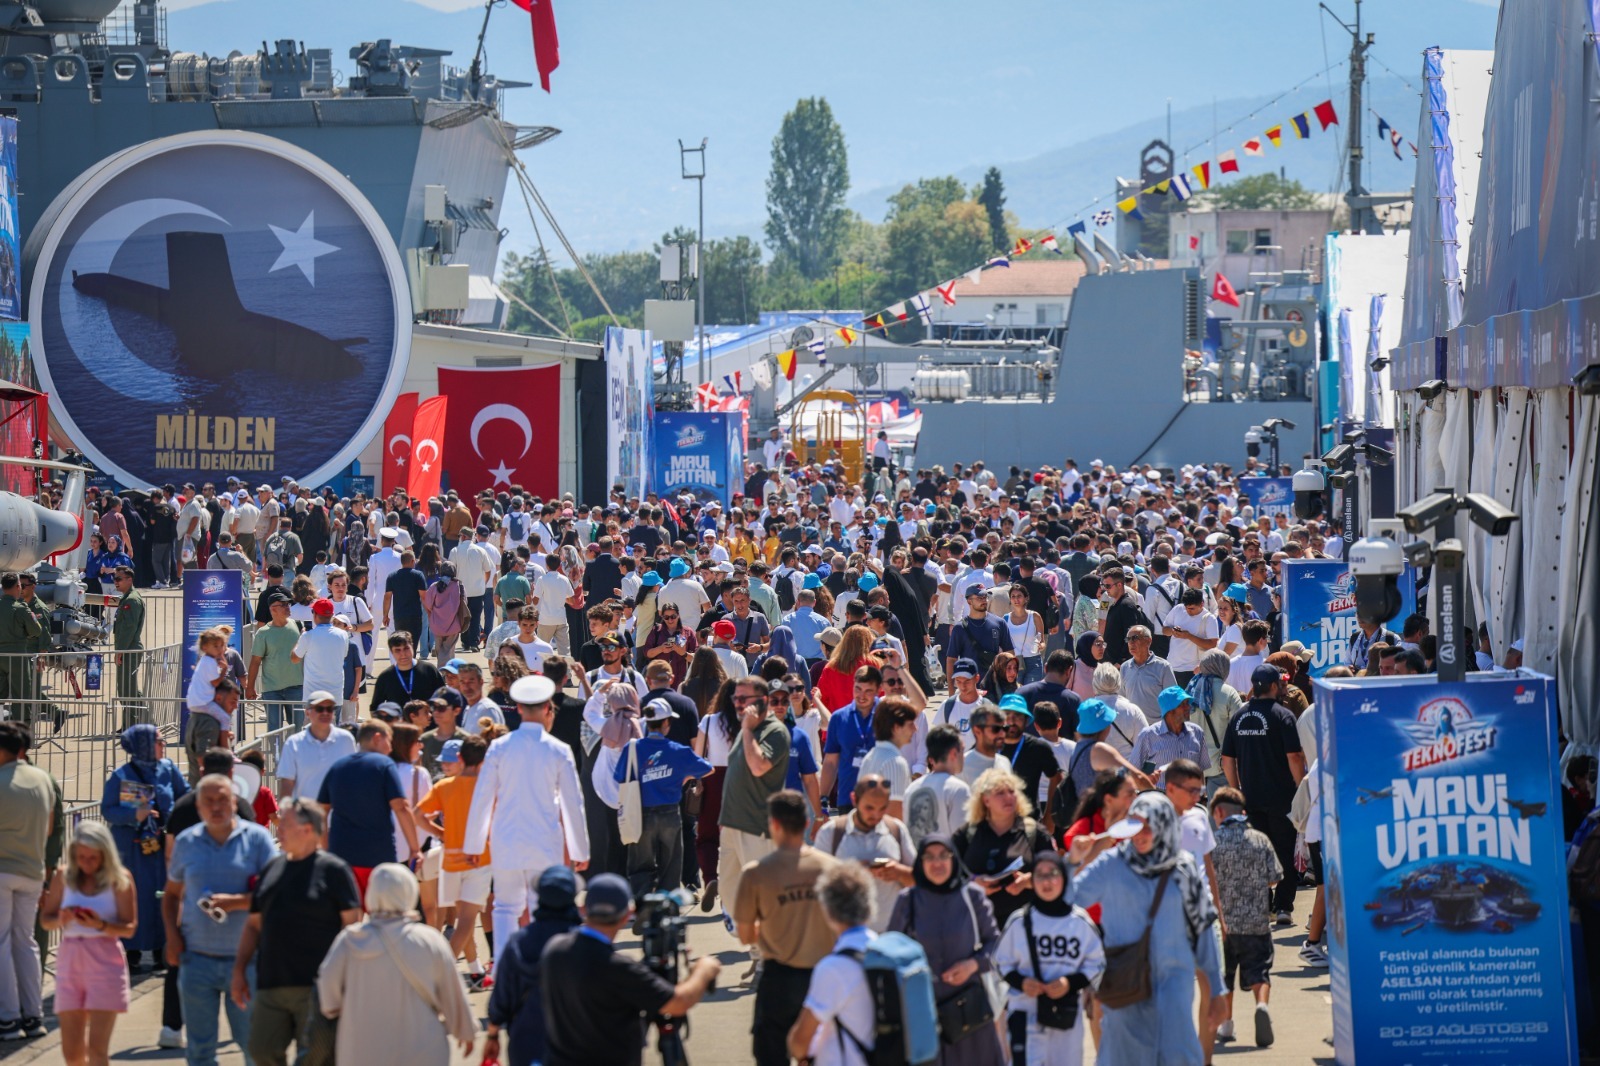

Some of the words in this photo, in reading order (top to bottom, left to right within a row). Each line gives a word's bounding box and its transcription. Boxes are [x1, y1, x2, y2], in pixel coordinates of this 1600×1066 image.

[155, 409, 276, 451] MİLDEN
[155, 450, 197, 470] MİLLİ
[200, 451, 275, 471] DENİZALTI
[664, 469, 717, 487] VATAN
[1344, 497, 1352, 530] aselsan
[1440, 585, 1453, 642] aselsan
[1402, 727, 1498, 772] TEKNOFEST
[1375, 814, 1532, 870] VATAN
[1033, 934, 1081, 959] 993
[1379, 949, 1429, 961] Festival
[1431, 948, 1486, 960] alanında
[1488, 946, 1540, 957] bulunan
[1384, 964, 1409, 975] tüm
[1412, 961, 1466, 975] güvenlik
[1469, 960, 1536, 972] kameraları
[1381, 976, 1442, 988] ASELSAN
[1445, 974, 1510, 986] tarafından
[1513, 973, 1542, 986] yerli
[1380, 992, 1396, 1002] ve
[1399, 988, 1426, 1000] milli
[1428, 987, 1468, 999] olarak
[1471, 986, 1544, 999] tasarlanmış
[1417, 1004, 1432, 1014] ve
[1436, 1001, 1508, 1014] üretilmiştir.
[1379, 1025, 1434, 1038] 20-23
